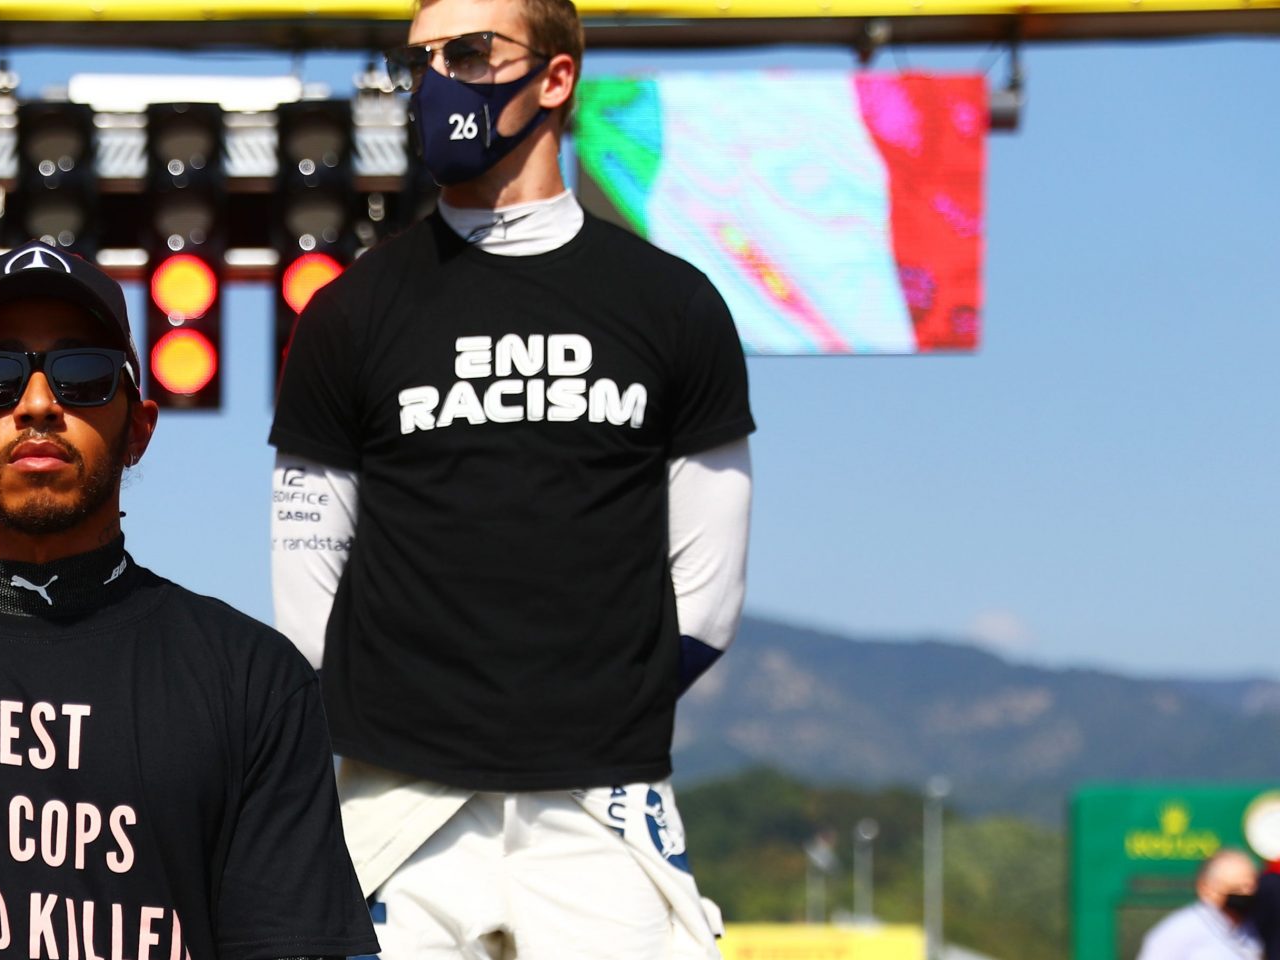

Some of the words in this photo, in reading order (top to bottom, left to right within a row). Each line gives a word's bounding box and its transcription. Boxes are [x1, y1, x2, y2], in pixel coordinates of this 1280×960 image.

[448, 112, 479, 140] 26
[455, 333, 593, 379] END
[398, 378, 648, 434] RACISM
[277, 510, 321, 522] CASIO
[9, 795, 137, 873] COPS
